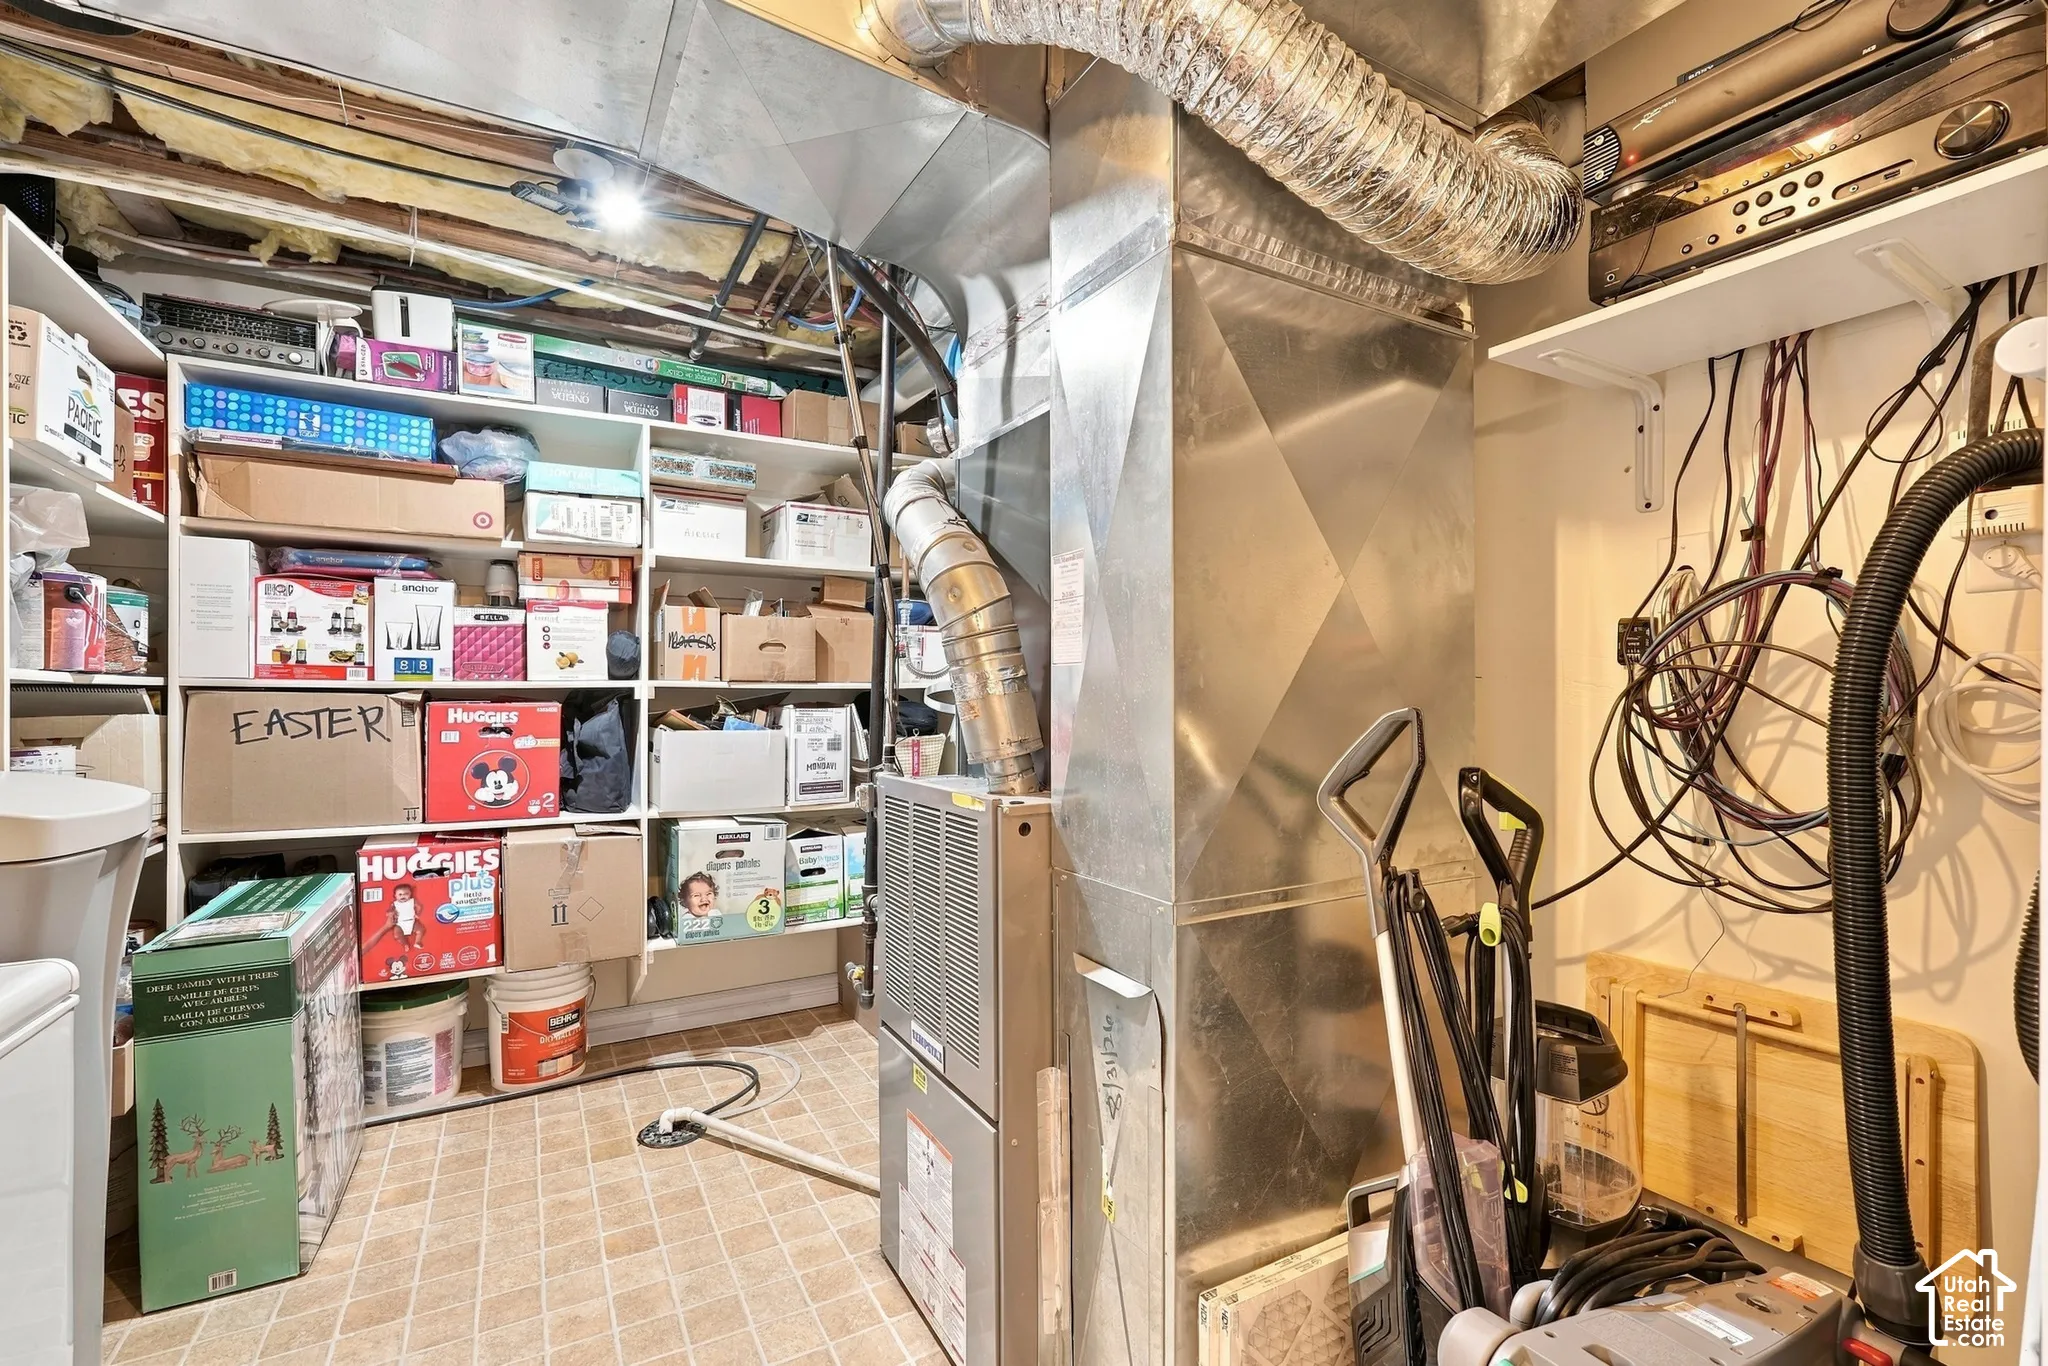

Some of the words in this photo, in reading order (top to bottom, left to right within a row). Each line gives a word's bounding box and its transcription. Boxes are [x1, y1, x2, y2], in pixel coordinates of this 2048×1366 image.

[551, 391, 589, 405] ONEIDA
[68, 396, 102, 438] PACIFIC
[624, 404, 659, 418] ONEIDA
[315, 556, 345, 564] anchor
[401, 584, 440, 594] anchor
[400, 660, 409, 671] 8
[419, 660, 428, 671] 8
[230, 705, 391, 745] EASTER
[806, 763, 837, 771] MONDAVI
[542, 793, 555, 808] 2
[359, 848, 500, 884] HUGGIES
[706, 861, 731, 872] diapers
[450, 876, 494, 897] plus
[758, 899, 770, 915] 3
[684, 918, 710, 932] 222
[485, 943, 497, 962] 1
[146, 984, 174, 994] DEER
[177, 979, 214, 990] FAMILY
[216, 975, 246, 985] WITH
[248, 970, 280, 981] TREES
[168, 991, 211, 1002] FAMILLE
[213, 988, 227, 996] DE
[229, 984, 260, 994] CERFS
[181, 1000, 208, 1009] AVEC
[210, 994, 248, 1005] ARBRES
[163, 1011, 205, 1022] FAMILIA
[207, 1008, 221, 1017] DE
[223, 1002, 265, 1014] CIERVOS
[549, 1012, 573, 1027] BEHR
[180, 1019, 203, 1028] CON
[1221, 1307, 1229, 1332] HDX
